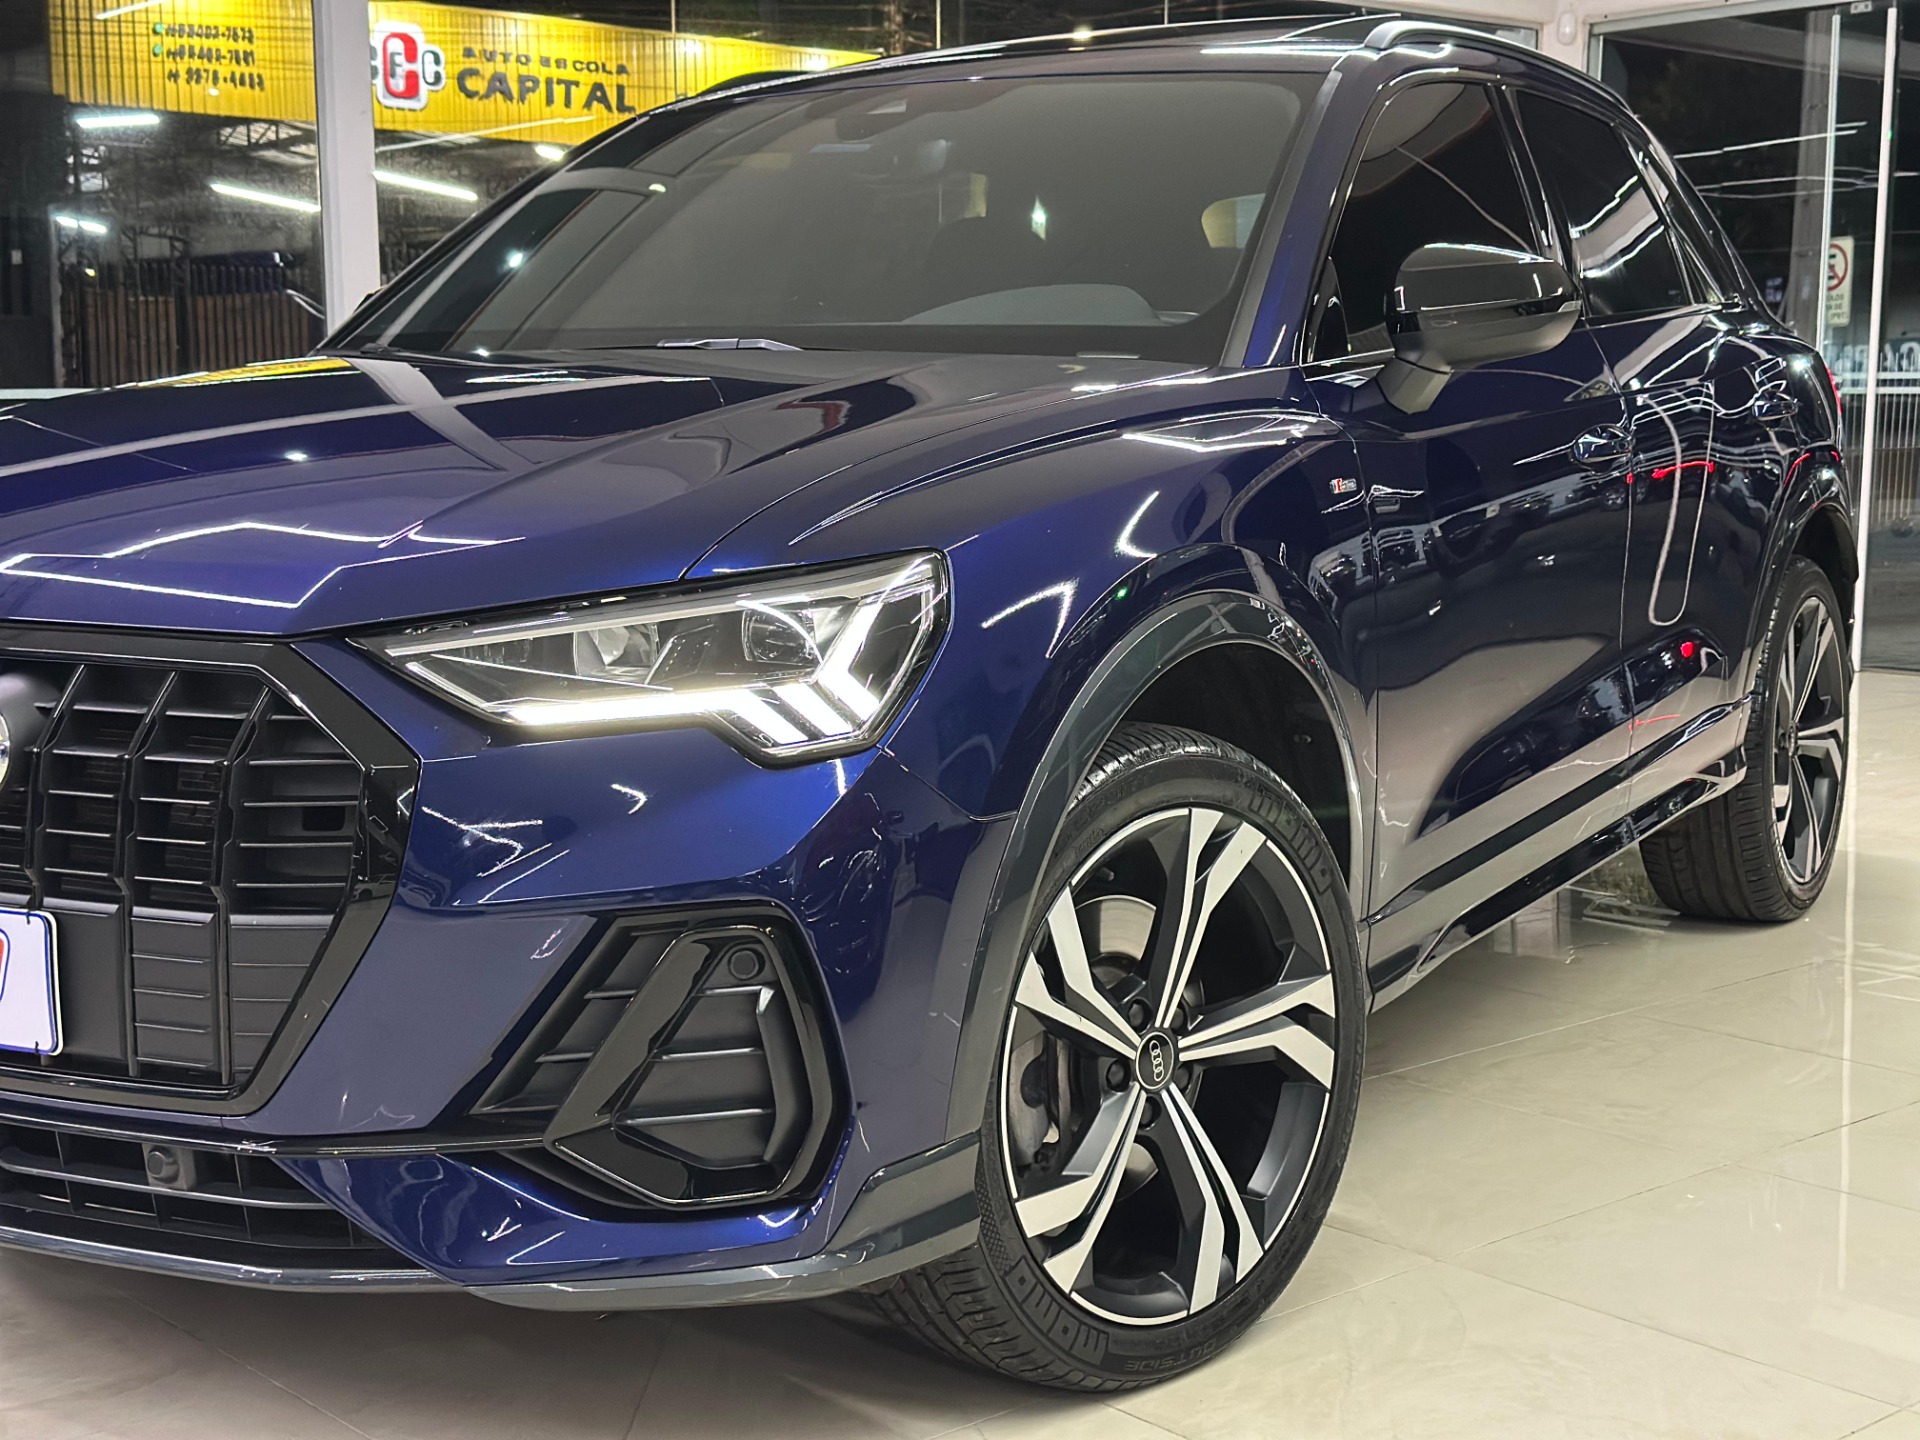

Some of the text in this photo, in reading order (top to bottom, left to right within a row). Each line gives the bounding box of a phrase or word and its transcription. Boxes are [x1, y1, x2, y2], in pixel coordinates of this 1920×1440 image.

[462, 46, 631, 76] AUTO ESCOLA
[456, 67, 637, 114] CAPITAL
[1004, 1256, 1110, 1366] MOMO
[1124, 1338, 1217, 1371] OUTSIDE
